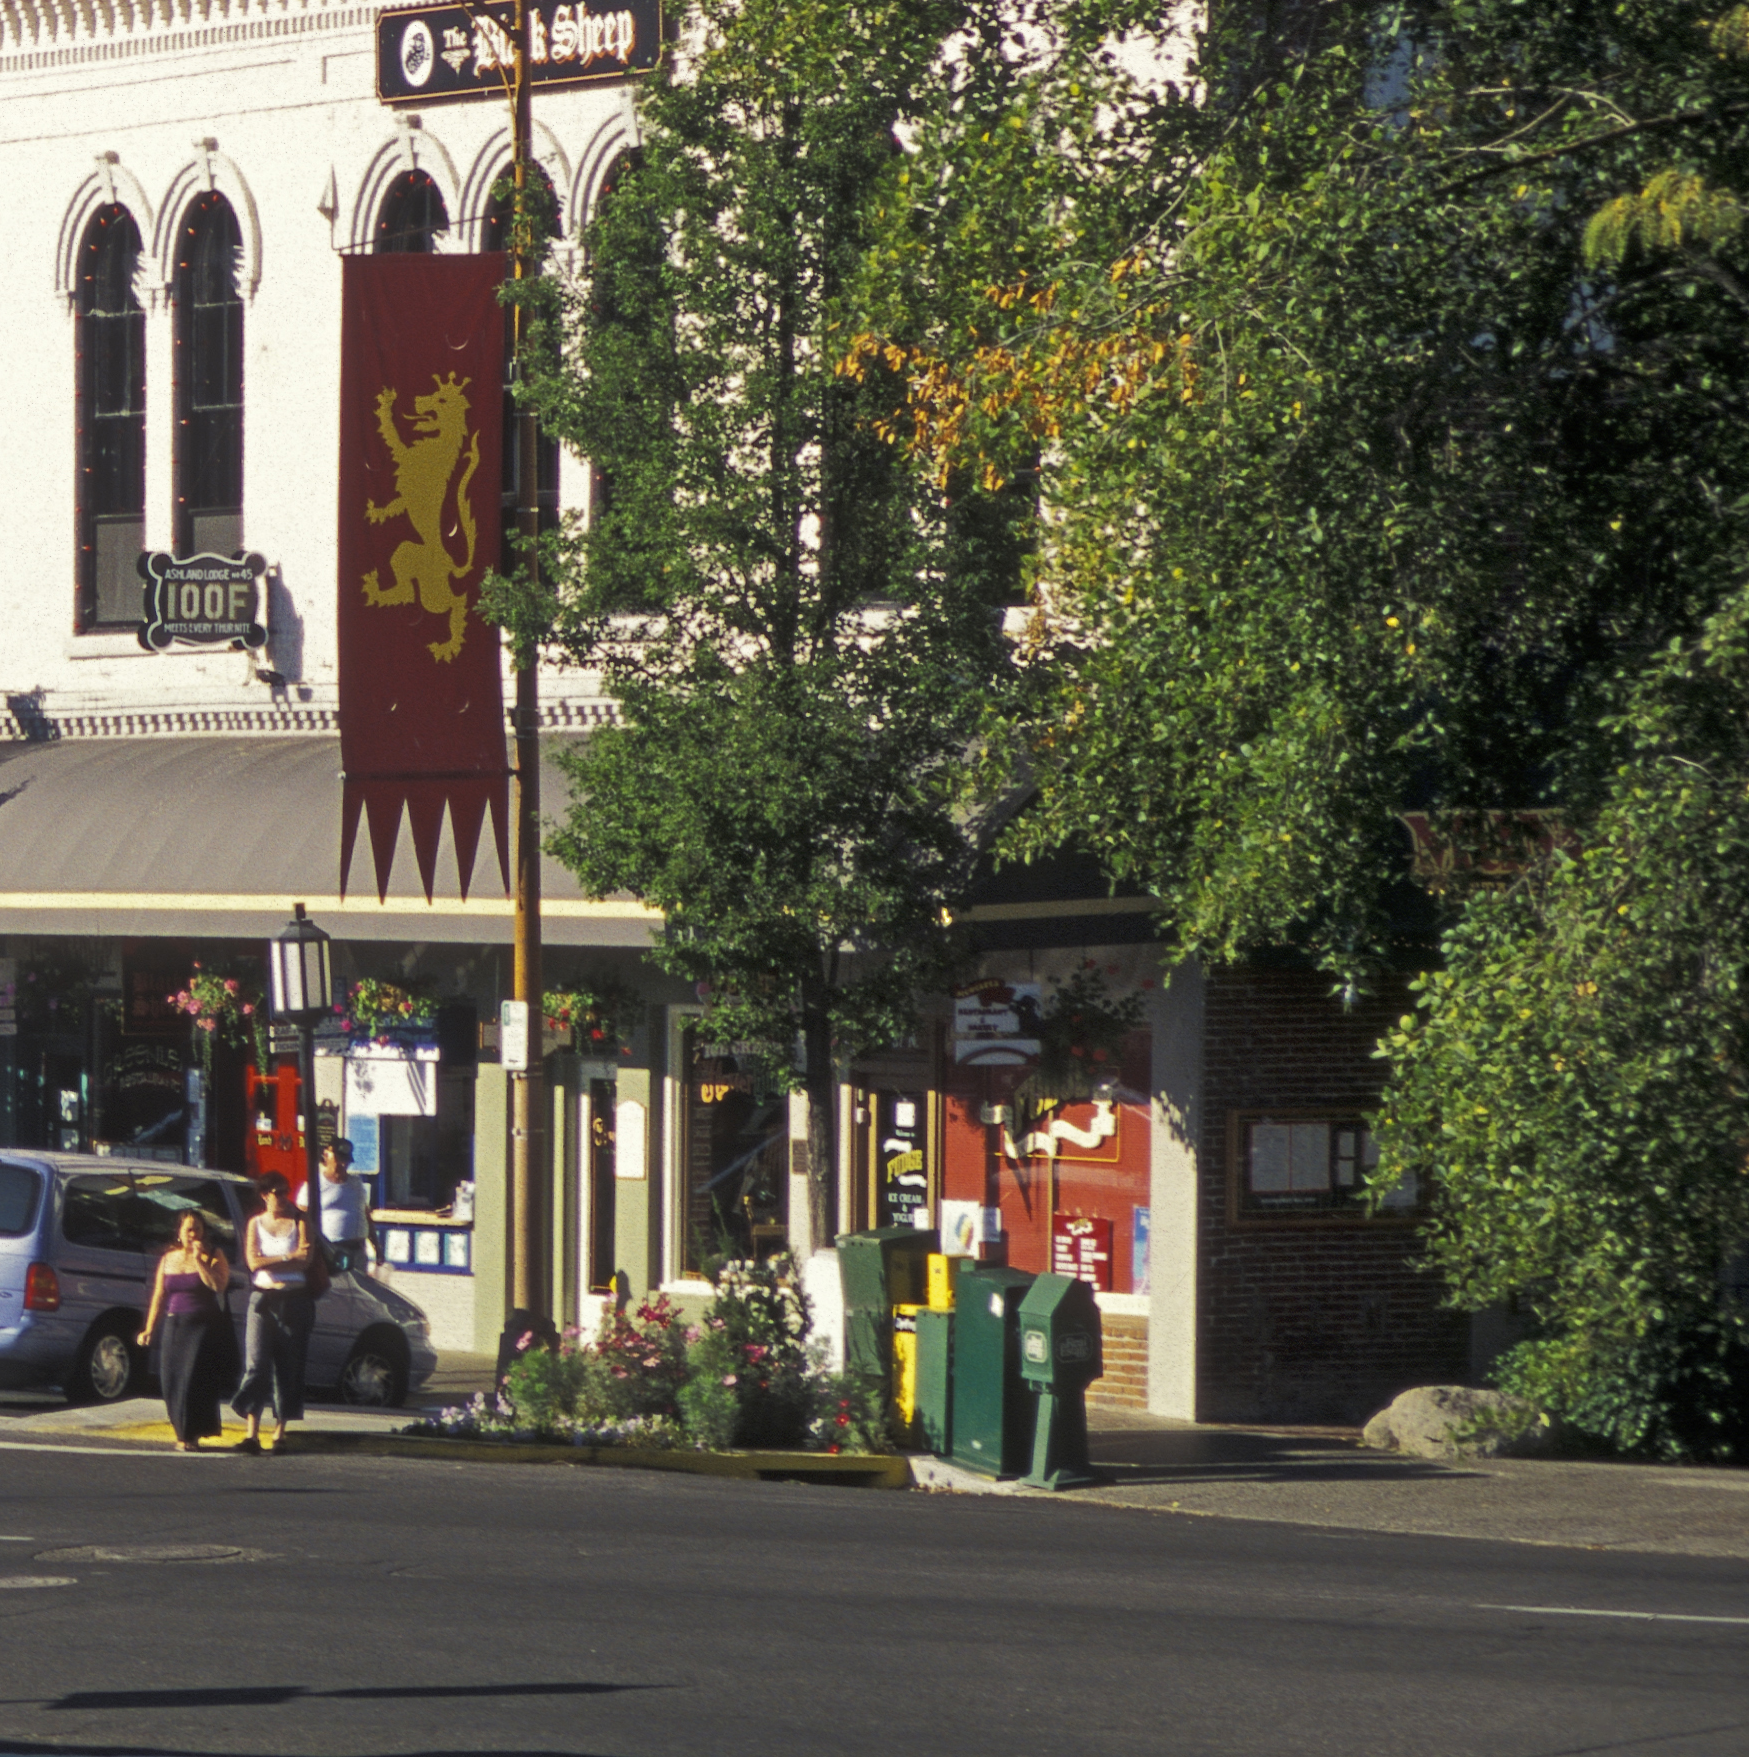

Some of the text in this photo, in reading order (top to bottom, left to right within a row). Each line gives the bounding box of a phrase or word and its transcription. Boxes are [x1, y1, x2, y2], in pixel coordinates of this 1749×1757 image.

[442, 0, 636, 79] The Blak Sheep
[164, 568, 203, 580] ASHLAND
[204, 568, 230, 580] LODGE
[241, 568, 253, 580] 45
[167, 582, 251, 620] IOOF
[164, 622, 251, 633] MEETS EVERY THUR NITE
